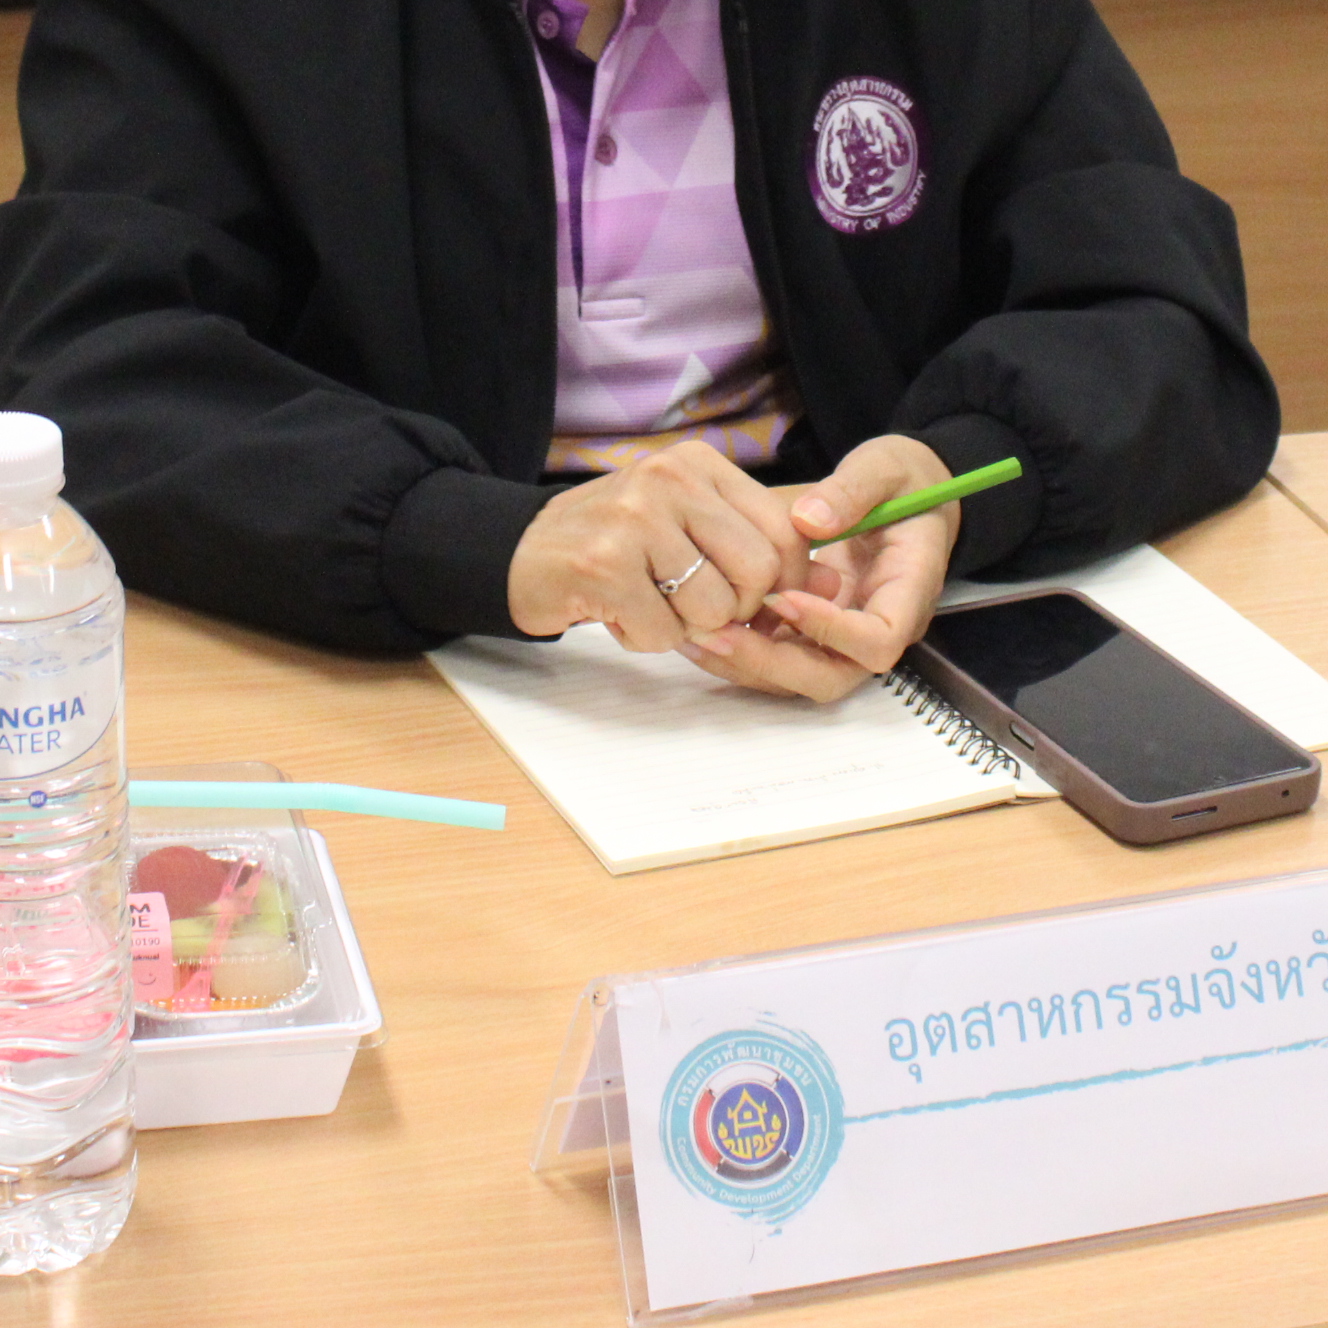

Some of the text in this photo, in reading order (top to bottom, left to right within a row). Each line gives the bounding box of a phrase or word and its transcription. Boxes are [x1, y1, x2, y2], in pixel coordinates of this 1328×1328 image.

[678, 1043, 812, 1107] กรมการพัฒนาชุมชน
[677, 1114, 822, 1205] Community Development Department
